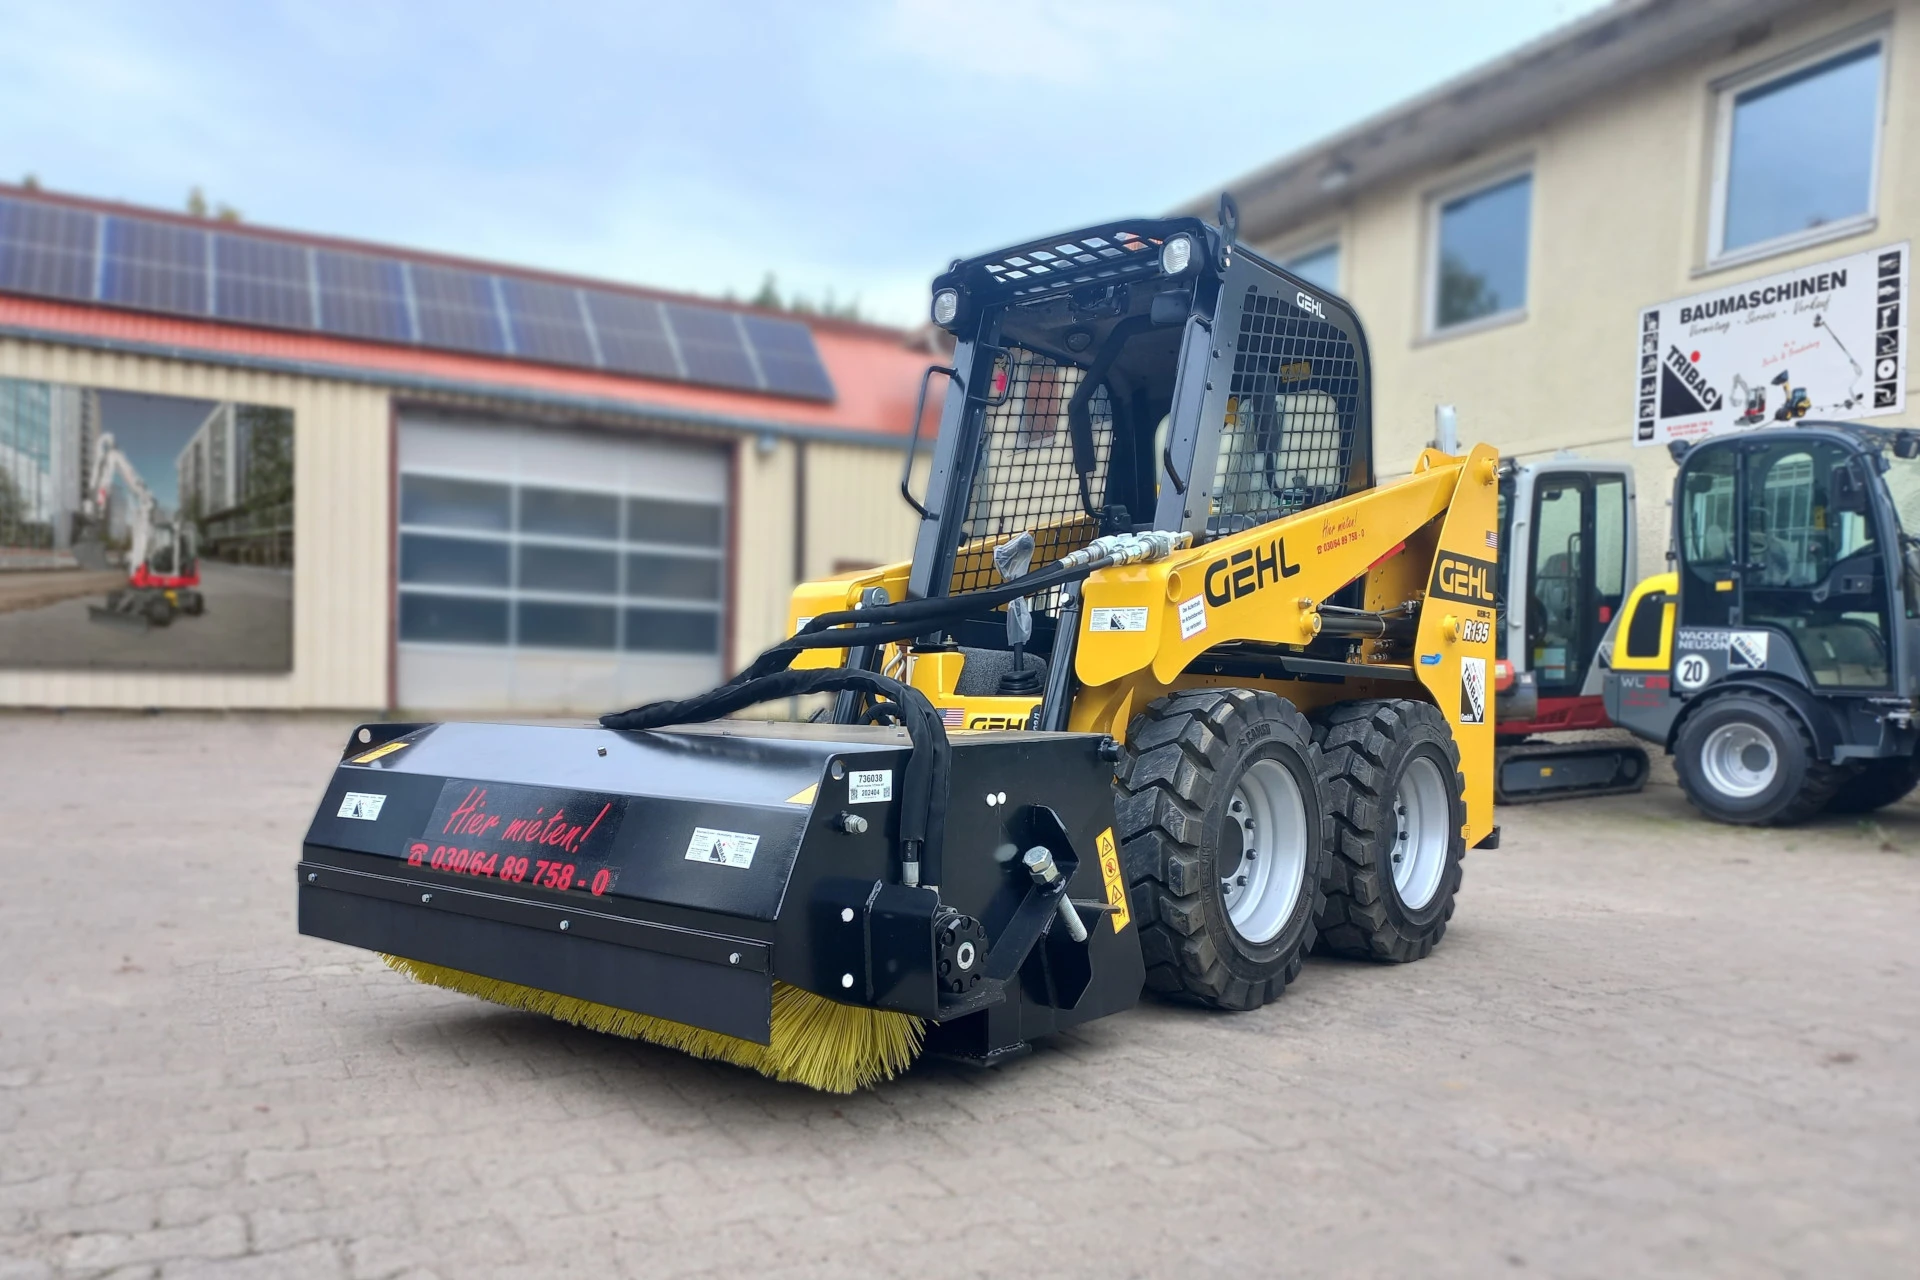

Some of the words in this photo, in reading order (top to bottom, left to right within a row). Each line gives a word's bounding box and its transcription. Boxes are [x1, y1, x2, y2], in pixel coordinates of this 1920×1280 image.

[1296, 291, 1326, 320] GEHL
[1680, 269, 1847, 325] BAUMASCHINEN
[1204, 536, 1300, 608] GEHL
[1439, 558, 1494, 601] GEHL
[1462, 618, 1490, 643] R135
[1678, 631, 1729, 640] WACKER
[1678, 640, 1729, 650] NEUSON
[1683, 660, 1703, 682] 20
[858, 774, 883, 783] 736038
[861, 788, 880, 797] 202404
[442, 786, 500, 837] Hier
[501, 802, 611, 854] mieten!
[430, 845, 499, 878] 030/64
[499, 855, 529, 883] 89
[532, 859, 576, 891] 758
[591, 867, 610, 896] 0
